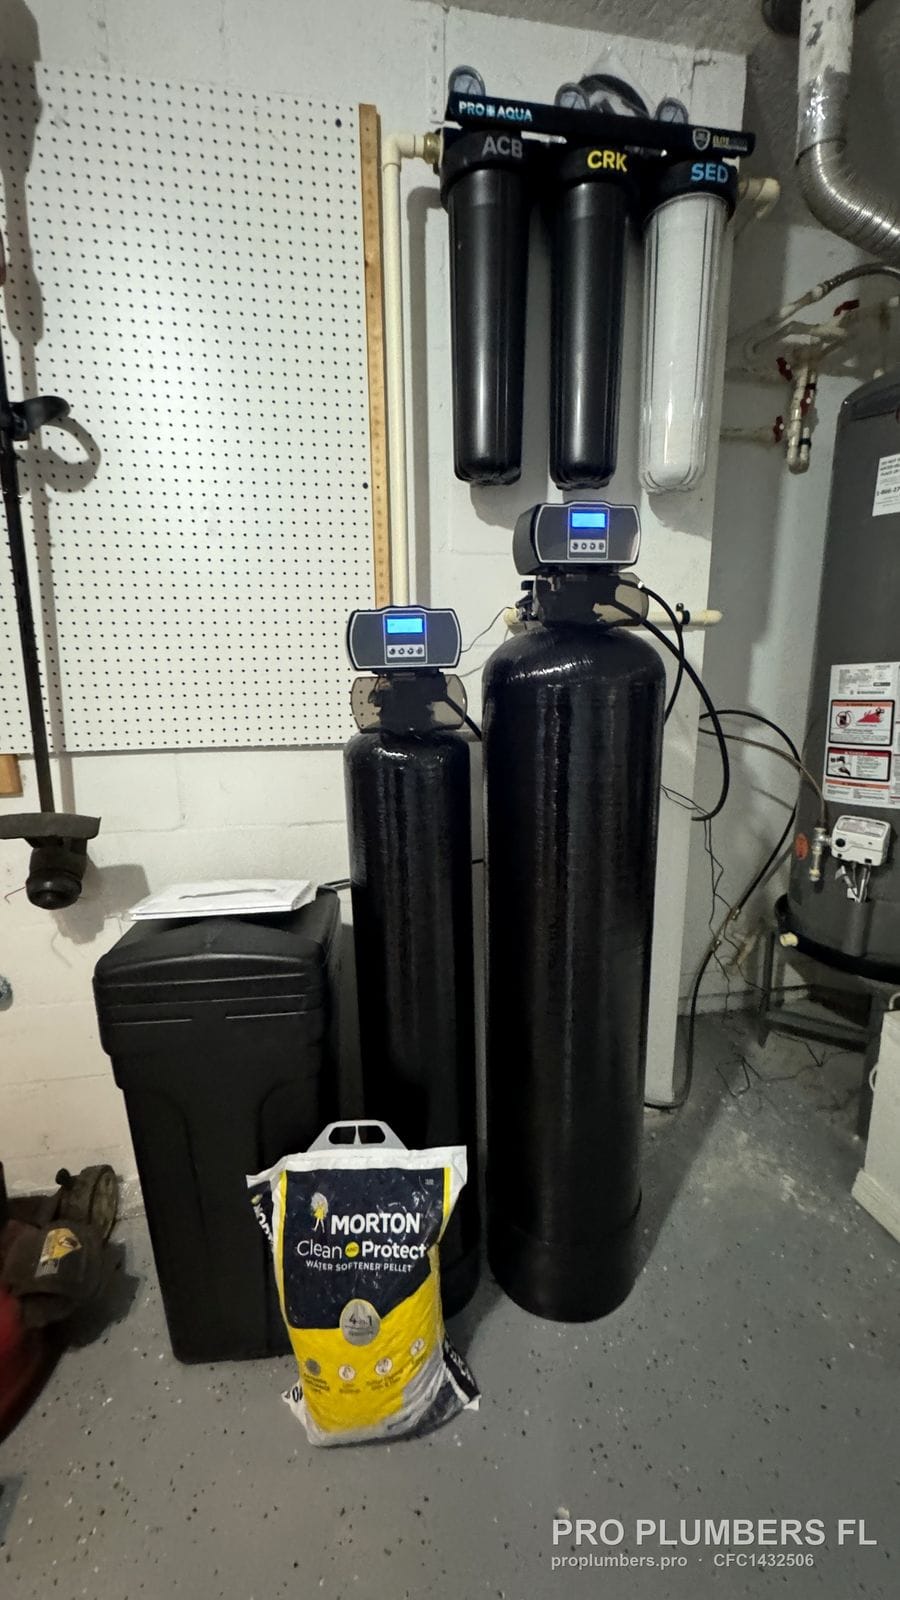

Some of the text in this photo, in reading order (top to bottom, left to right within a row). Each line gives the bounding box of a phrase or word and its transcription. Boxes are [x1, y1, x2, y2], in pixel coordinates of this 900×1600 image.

[459, 101, 533, 121] PRO AQUA
[482, 134, 523, 158] ACB
[587, 150, 628, 172] CRK
[691, 162, 729, 183] SED
[330, 1212, 421, 1236] MORTON
[297, 1239, 343, 1259] Clean
[361, 1240, 427, 1260] Protect
[306, 1259, 412, 1273] WATER SOFTENER PELLET
